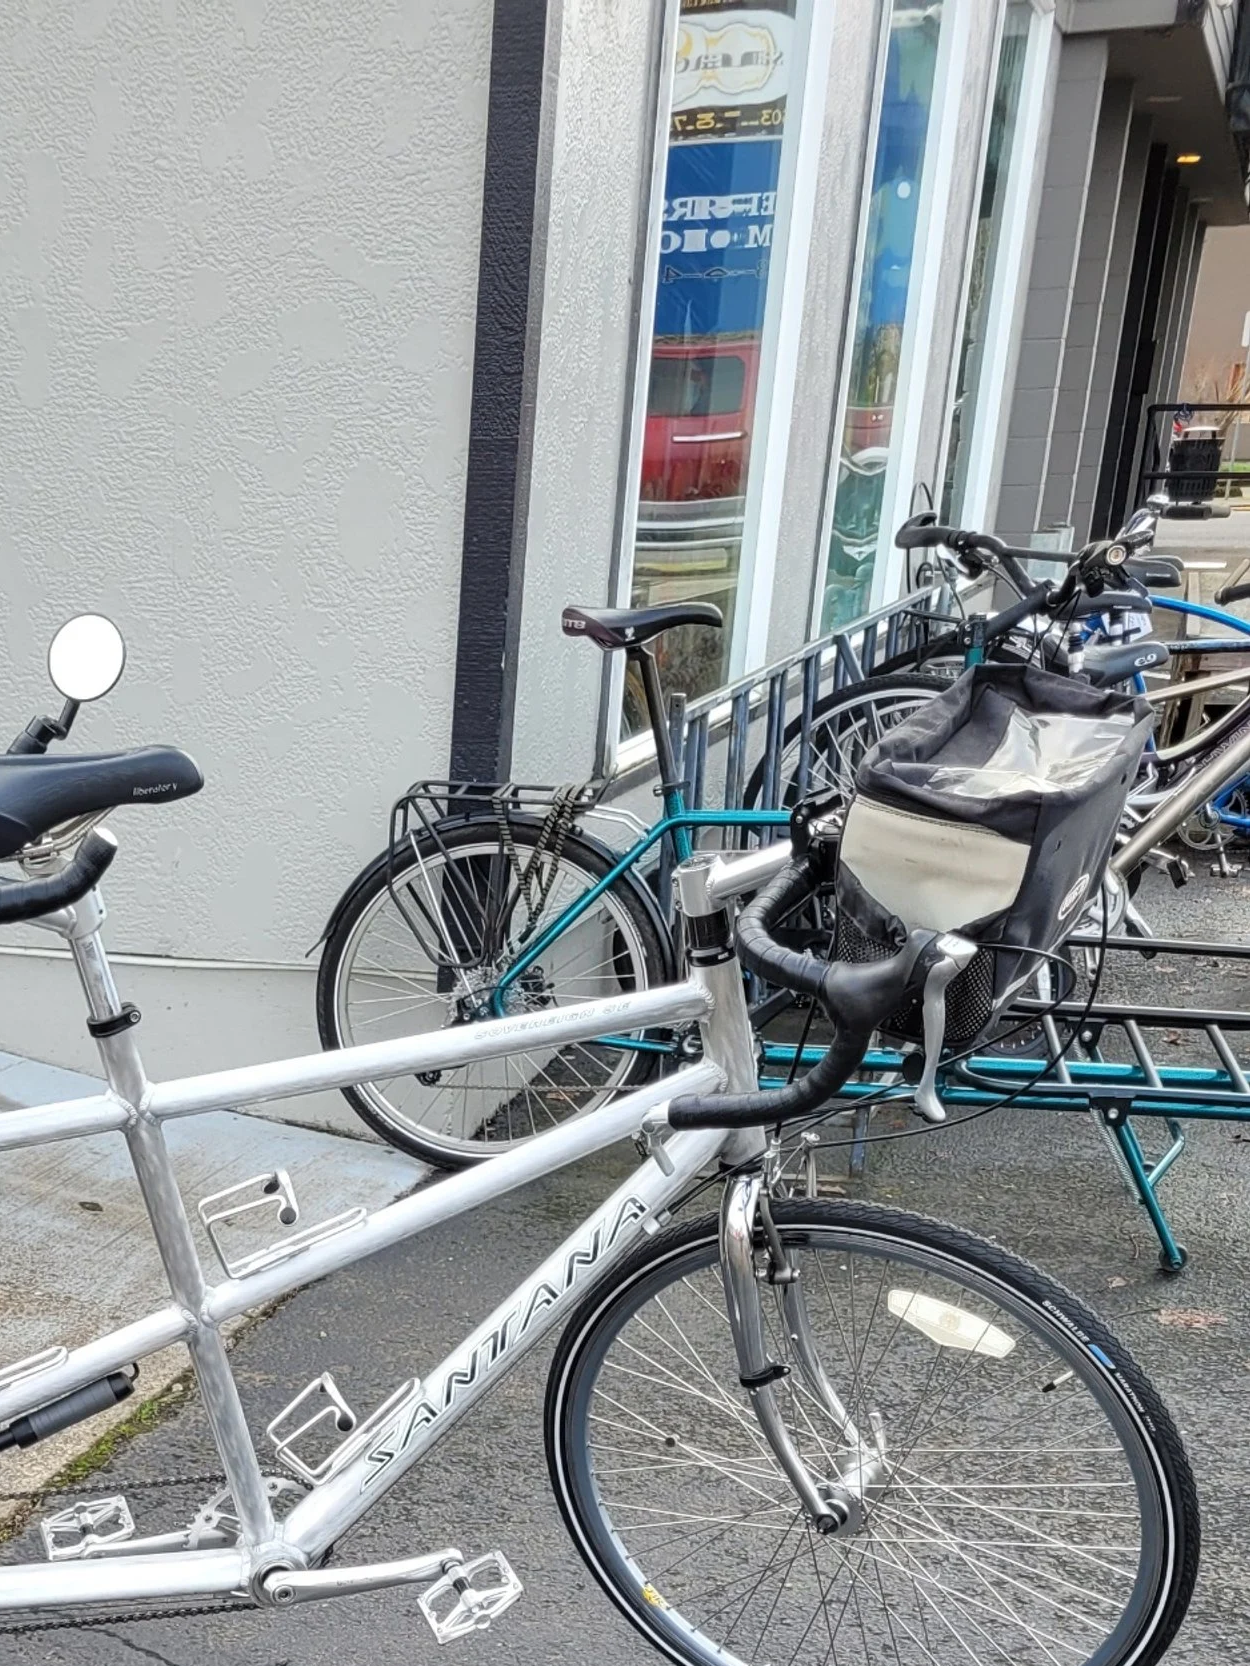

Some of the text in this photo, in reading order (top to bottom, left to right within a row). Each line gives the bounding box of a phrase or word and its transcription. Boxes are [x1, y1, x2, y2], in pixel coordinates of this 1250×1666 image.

[132, 783, 172, 797] liberator
[474, 1008, 595, 1040] SOVEREIGN
[360, 1194, 649, 1493] SANTANA
[1042, 1300, 1146, 1414] SCHWALBE MARATHON
